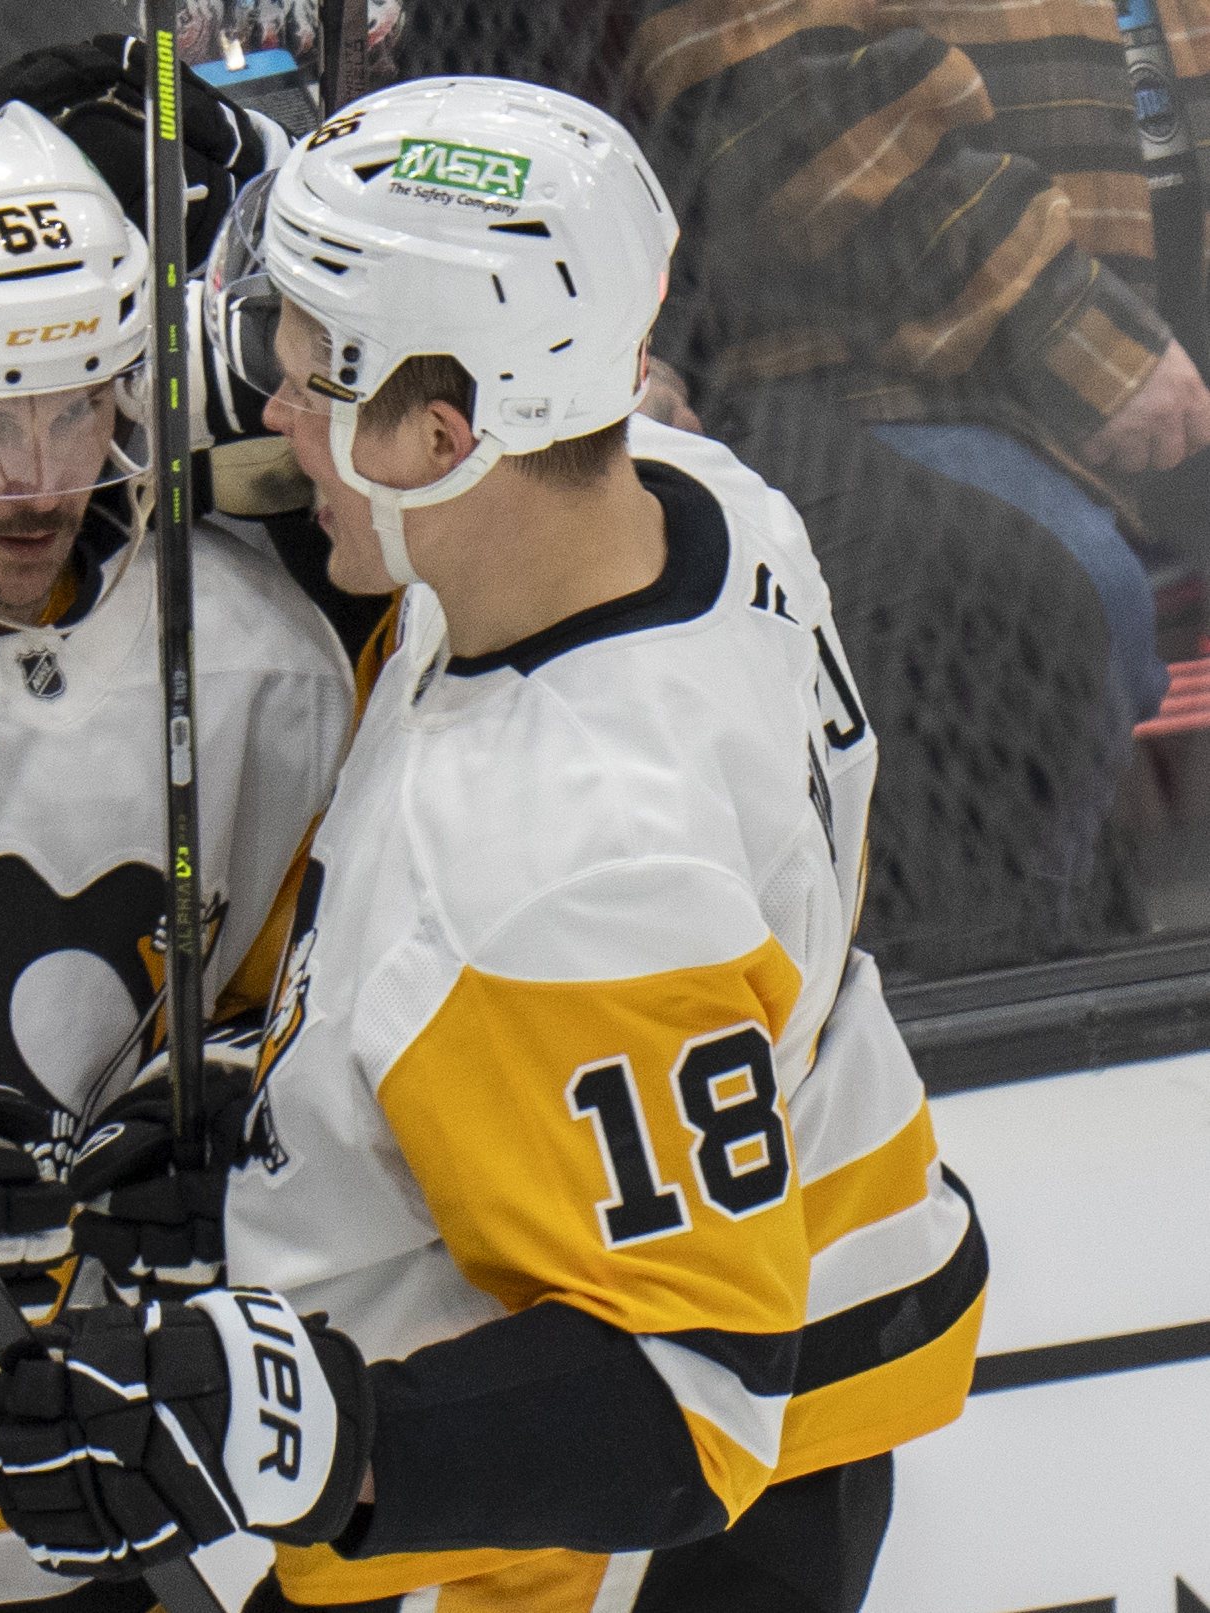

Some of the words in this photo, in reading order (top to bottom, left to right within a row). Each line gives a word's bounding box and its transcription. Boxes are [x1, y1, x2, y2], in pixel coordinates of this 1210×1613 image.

[156, 30, 176, 140] WARRIOR
[399, 144, 521, 197] MSA
[390, 182, 412, 196] The
[415, 185, 454, 206] Safety
[457, 193, 519, 217] Company
[5, 316, 101, 346] CCM
[568, 1020, 790, 1248] 18
